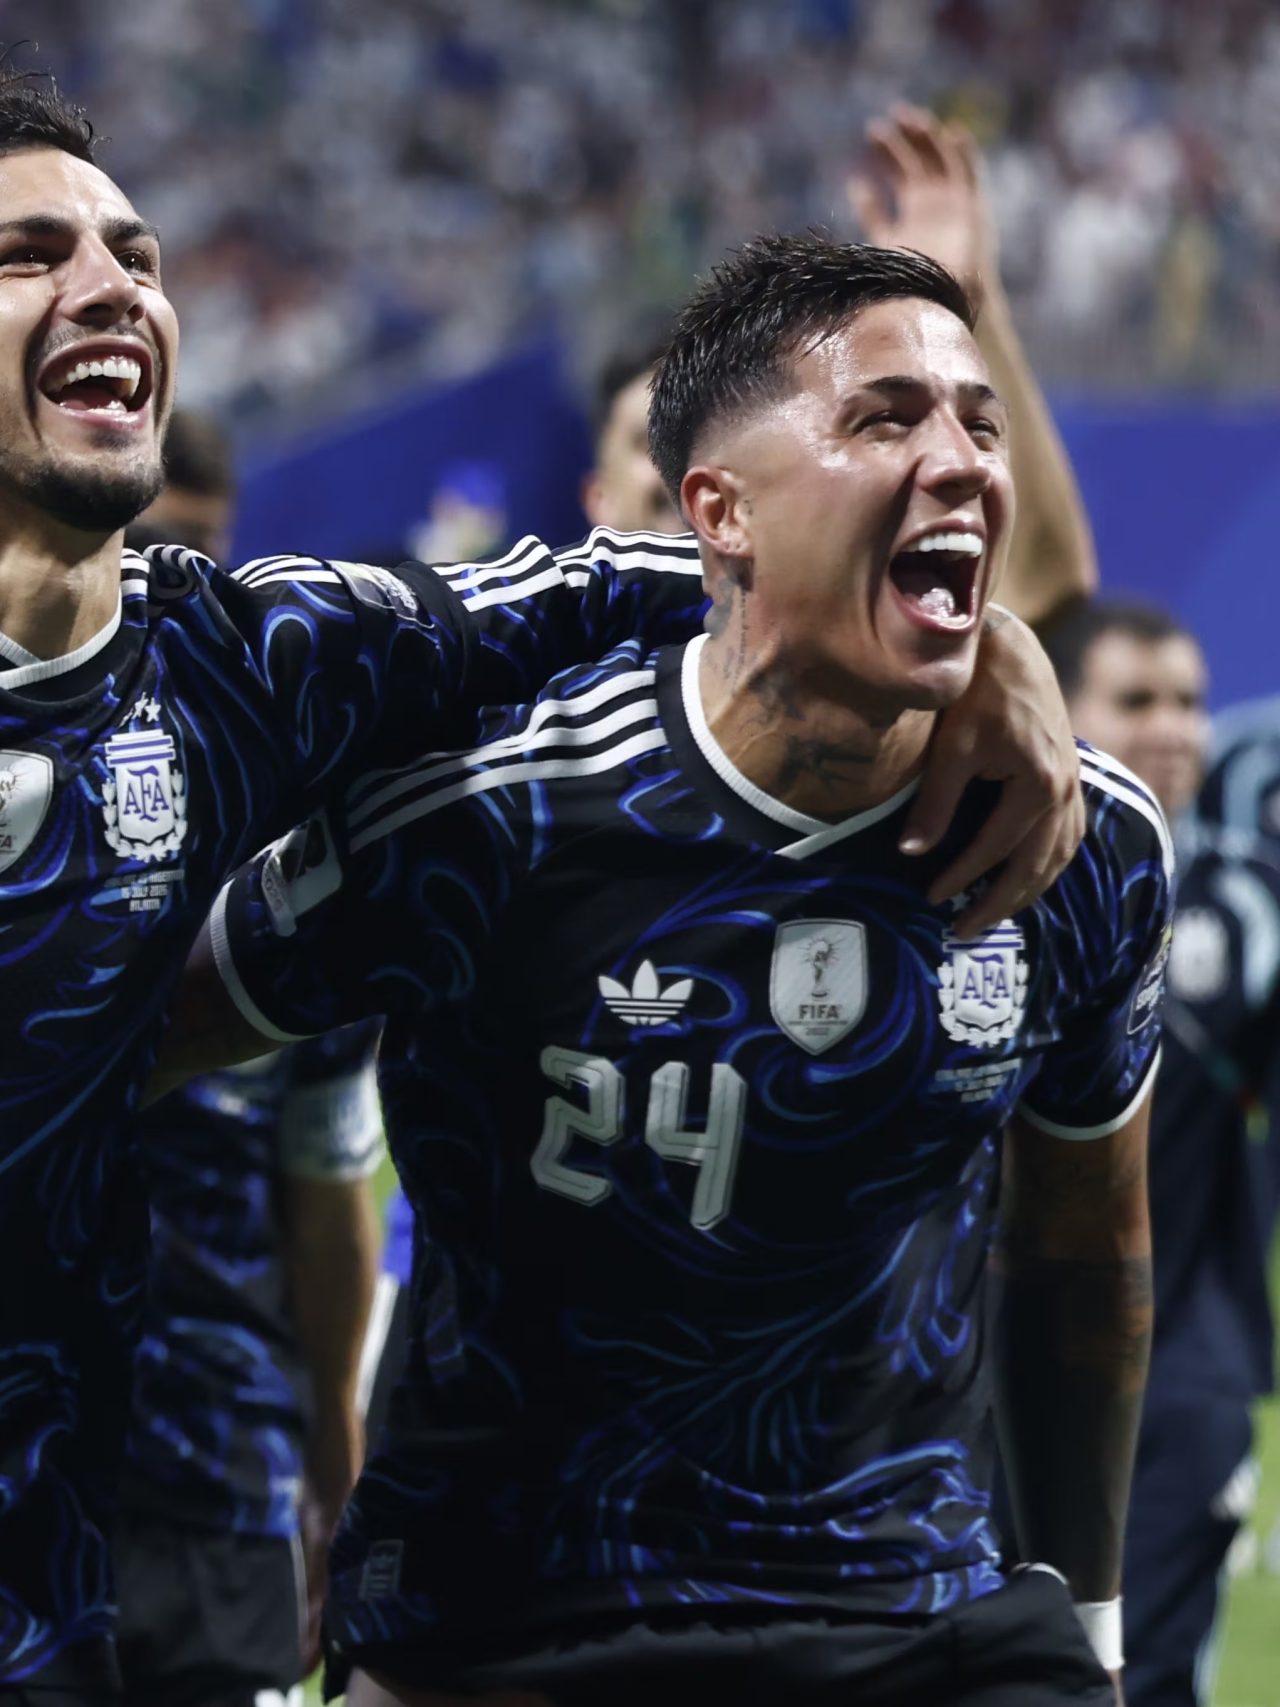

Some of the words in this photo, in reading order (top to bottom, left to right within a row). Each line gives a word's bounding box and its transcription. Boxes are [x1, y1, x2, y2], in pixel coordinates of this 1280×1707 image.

[123, 765, 170, 822] AFA
[960, 954, 1010, 1009] AFA
[799, 1004, 839, 1019] FIFA
[530, 1045, 748, 1231] 24
